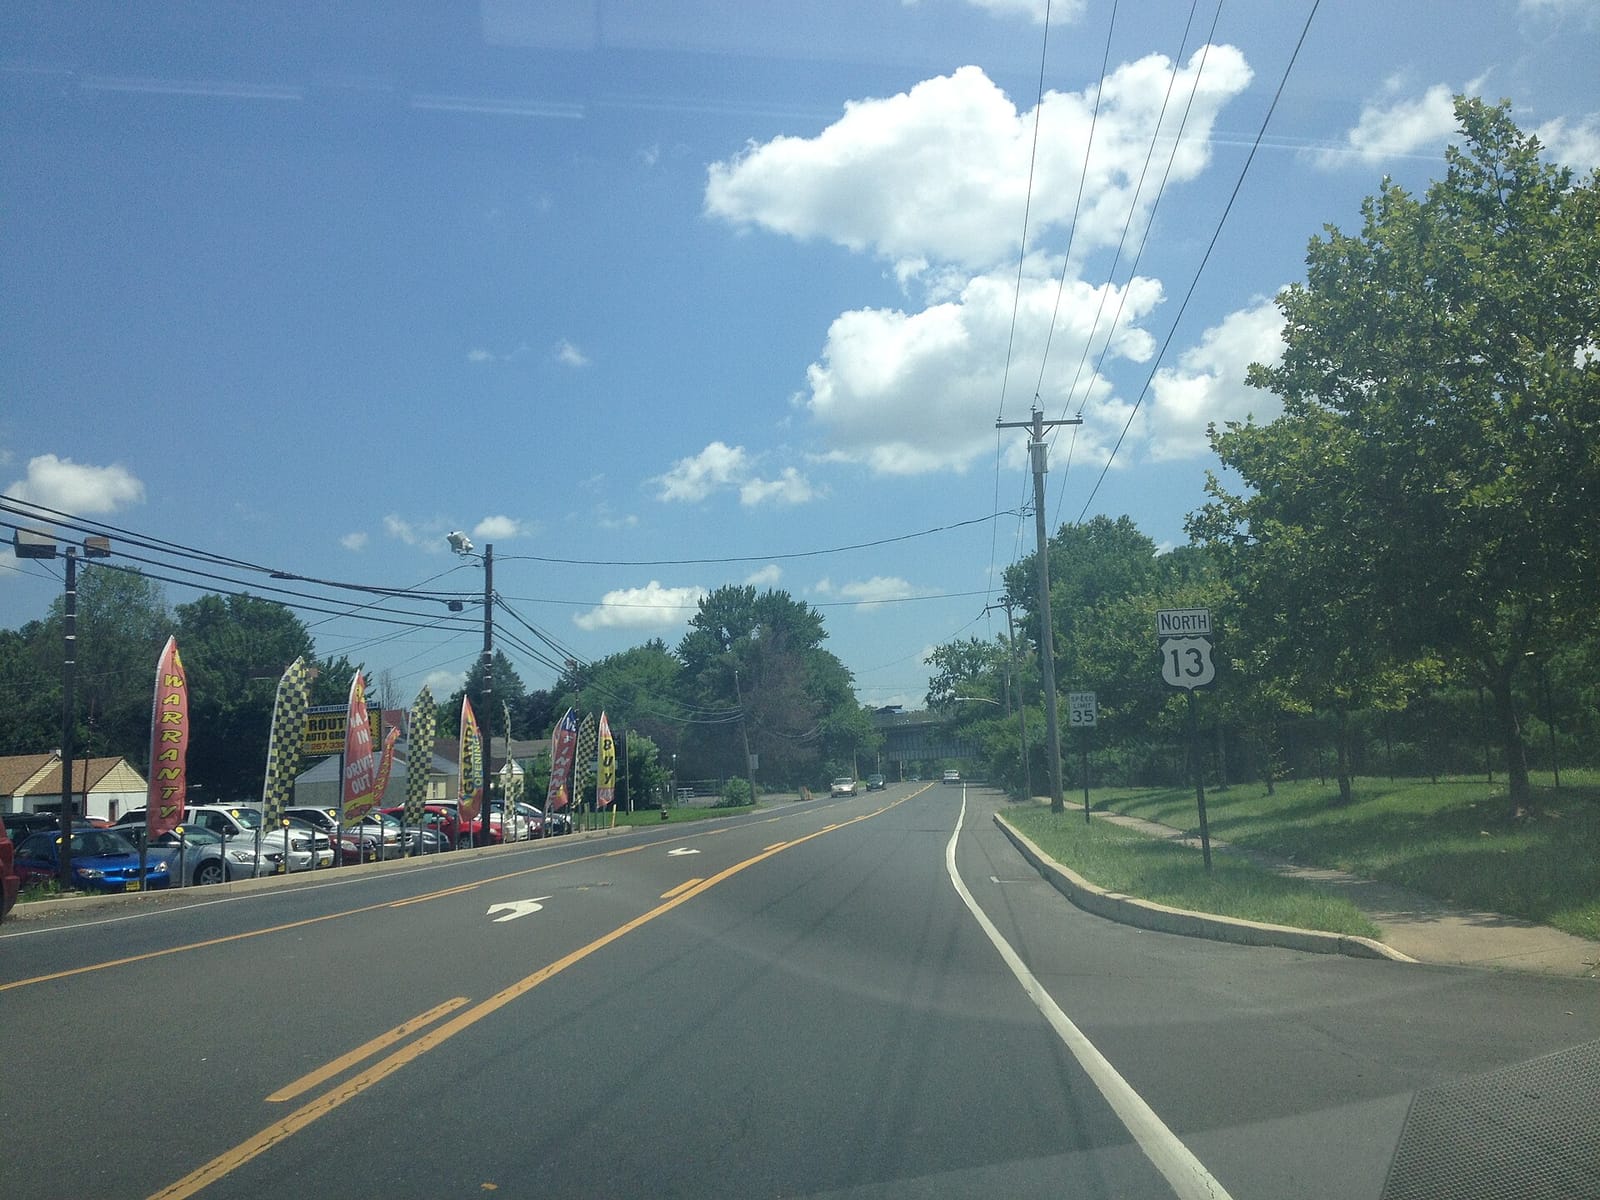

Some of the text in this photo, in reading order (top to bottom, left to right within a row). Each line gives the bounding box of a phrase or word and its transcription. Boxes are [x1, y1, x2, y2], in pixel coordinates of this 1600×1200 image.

[1161, 614, 1207, 630] NORTH
[1170, 647, 1204, 678] 13
[309, 718, 346, 731] ROUT
[1072, 710, 1094, 723] 35
[306, 731, 345, 741] AUTO GRO
[357, 729, 369, 745] IN
[157, 674, 183, 818] WARRANTY
[463, 725, 474, 795] GRAND
[603, 738, 614, 785] BUY
[351, 774, 371, 794] OUT
